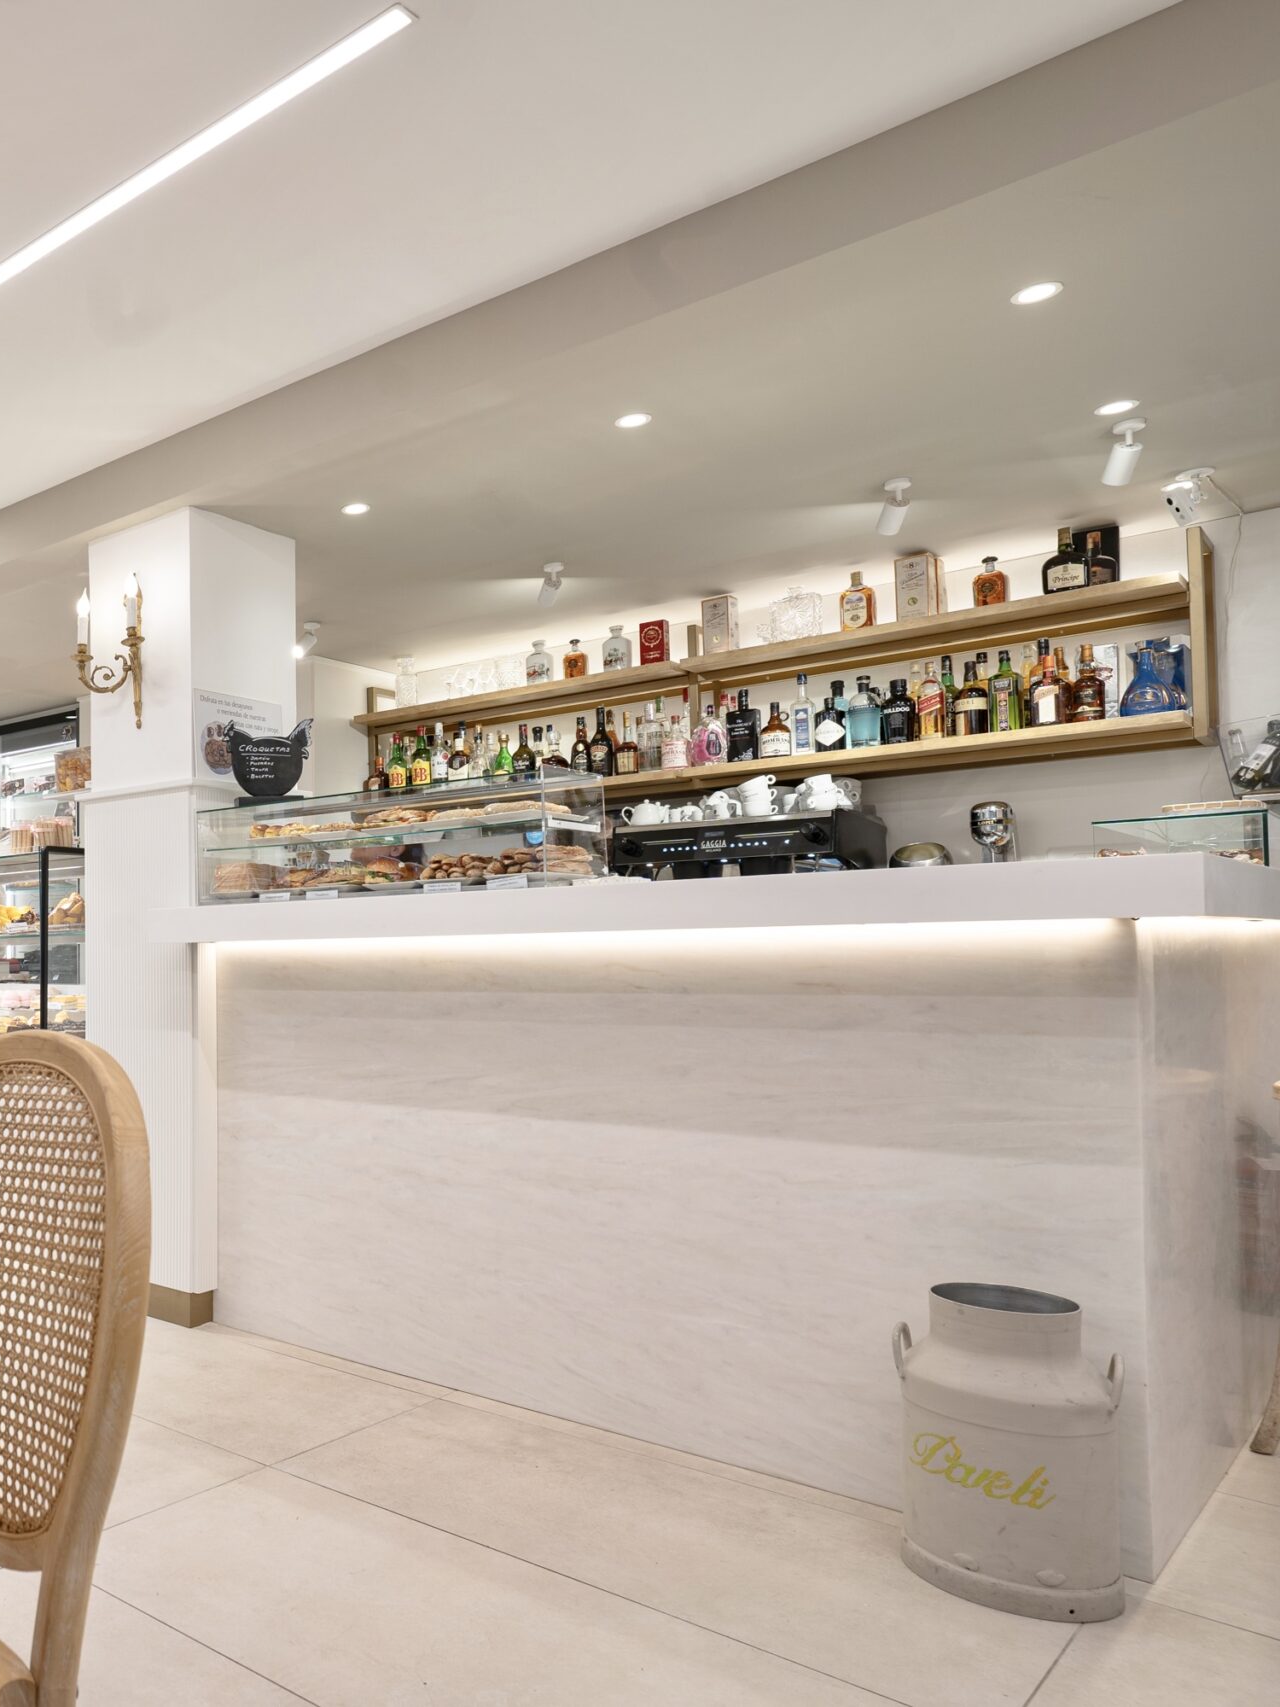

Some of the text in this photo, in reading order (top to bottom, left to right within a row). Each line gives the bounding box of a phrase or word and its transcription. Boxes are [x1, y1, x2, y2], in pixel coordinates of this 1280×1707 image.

[883, 706, 910, 714] BULLDOG
[238, 744, 290, 753] CROQUETAS
[701, 840, 727, 849] GAGGIA
